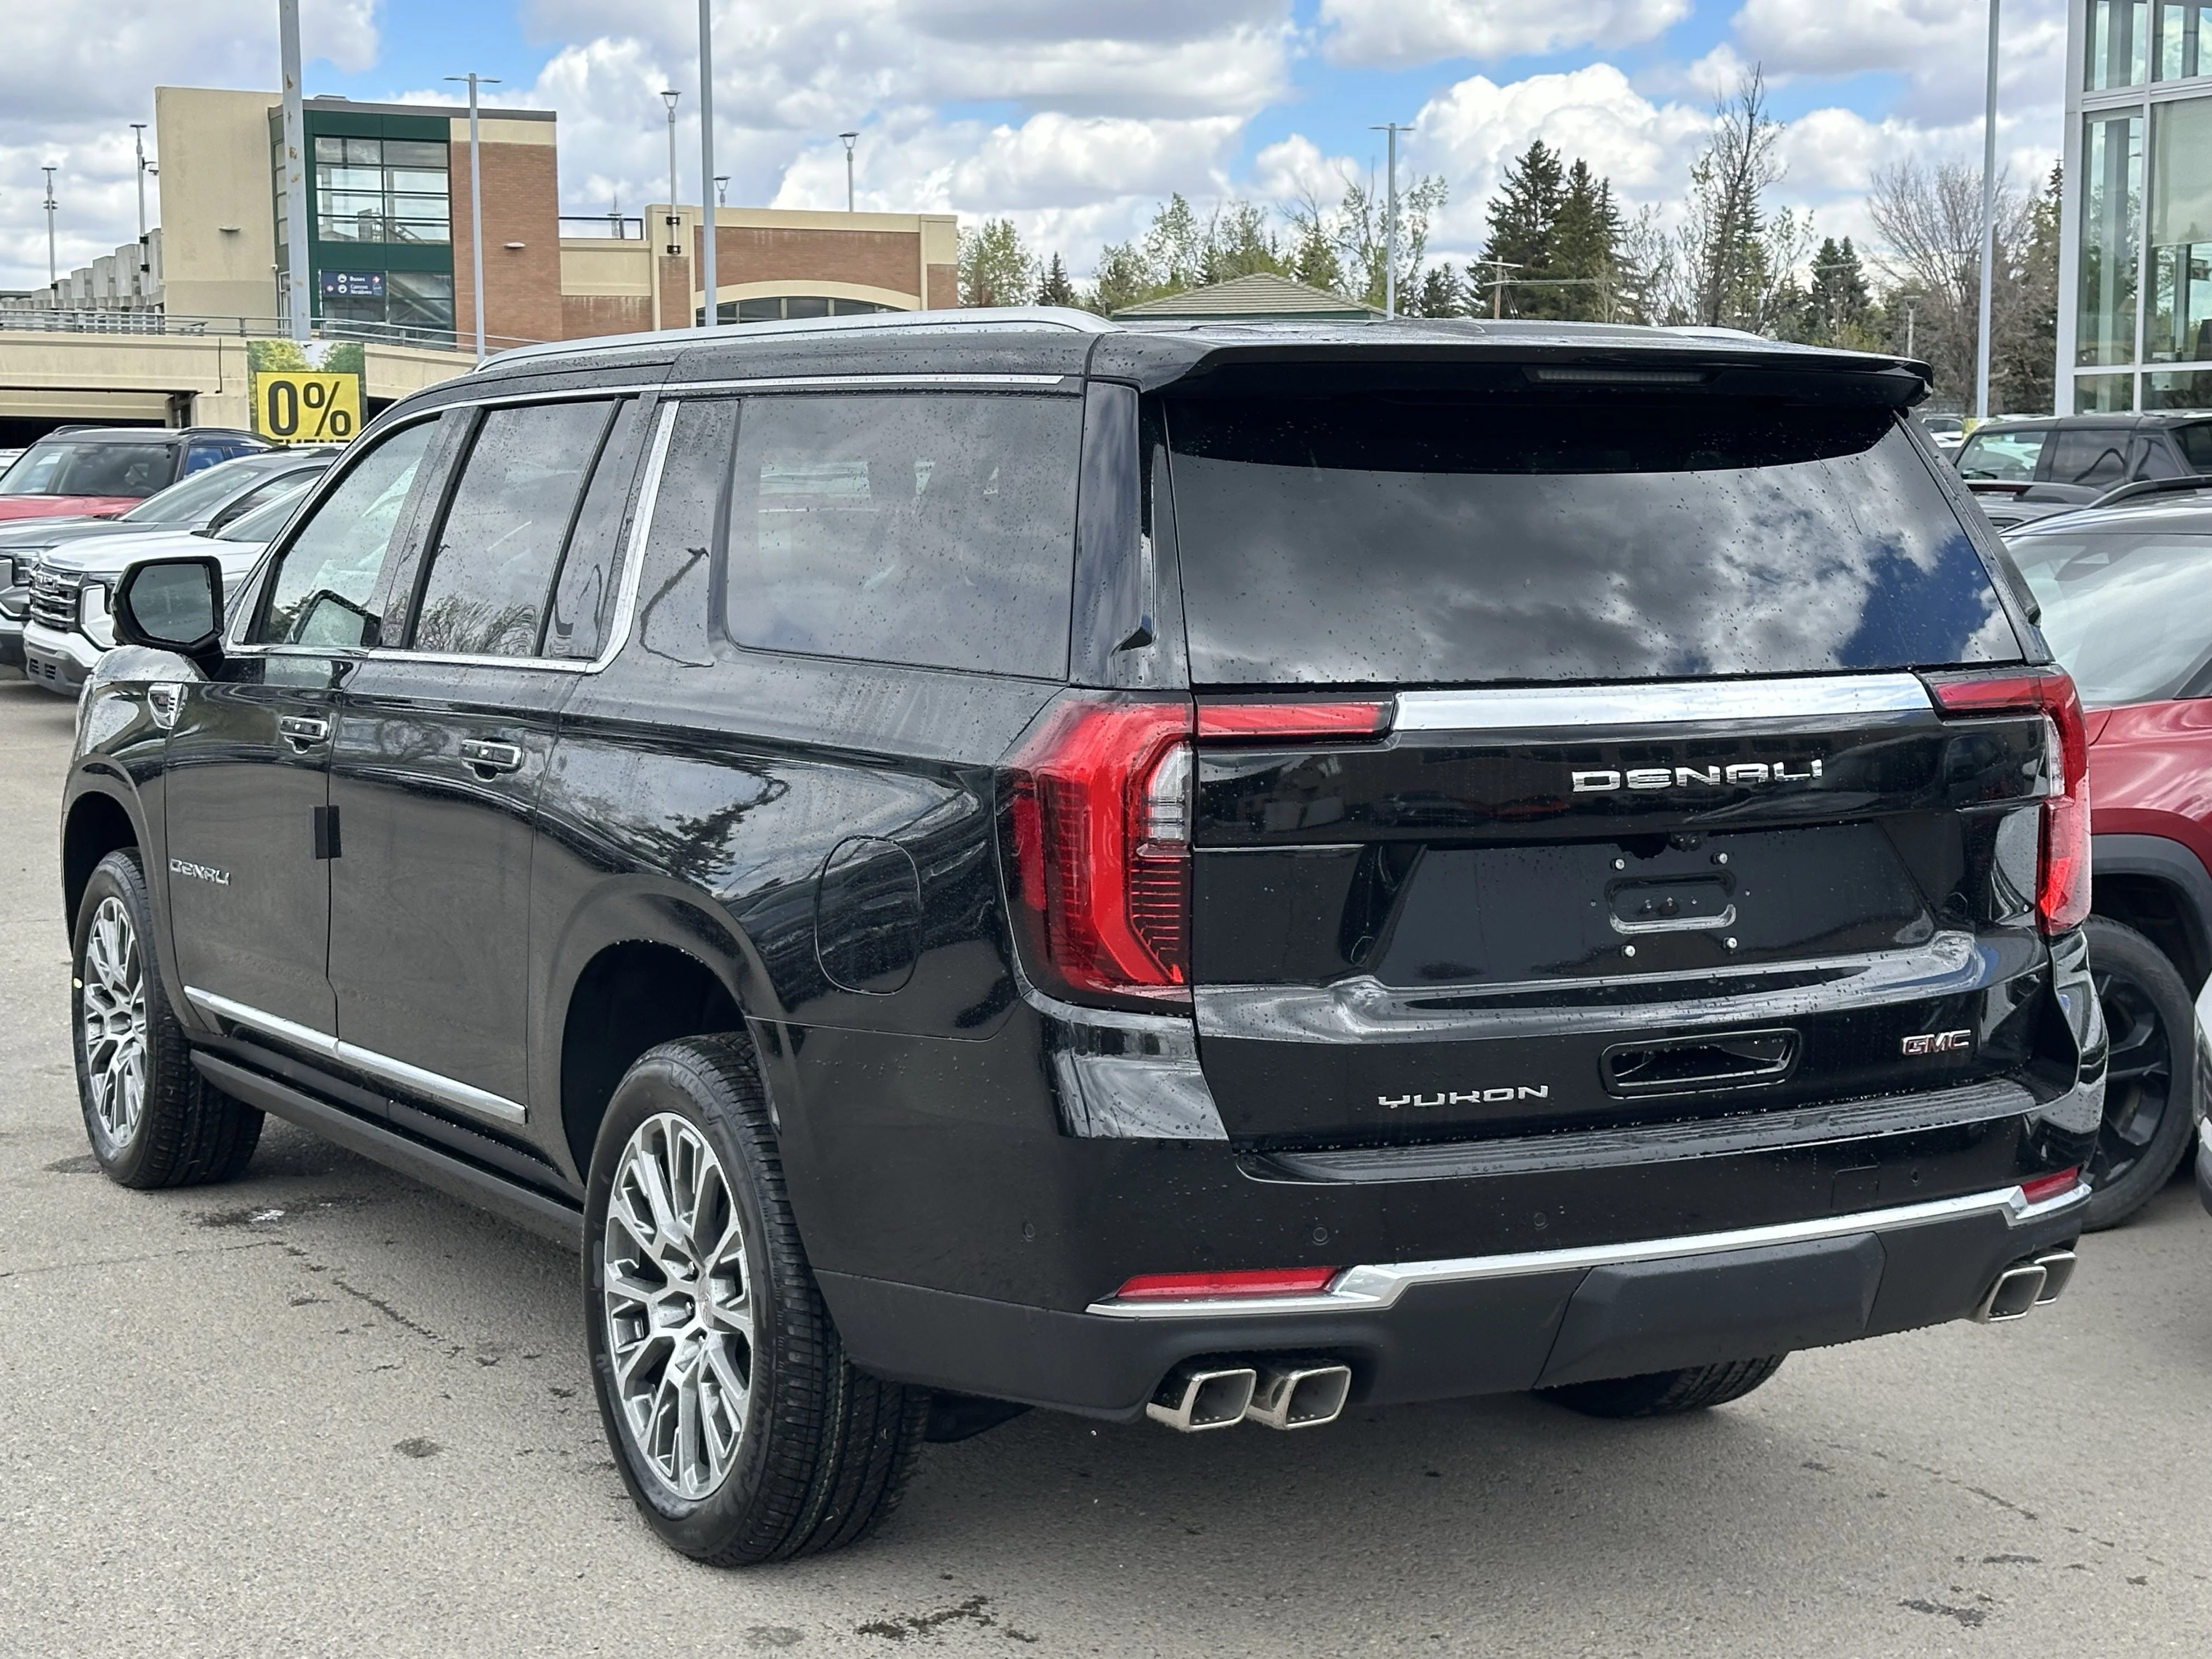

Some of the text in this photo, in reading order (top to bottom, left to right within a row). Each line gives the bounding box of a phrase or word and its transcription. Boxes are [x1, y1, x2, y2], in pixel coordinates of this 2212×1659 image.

[268, 380, 351, 437] 0%
[1572, 759, 1822, 793] DENALI
[170, 857, 230, 886] DENALI
[1902, 1029, 1971, 1056] GMC
[1378, 1085, 1549, 1109] YUKON
